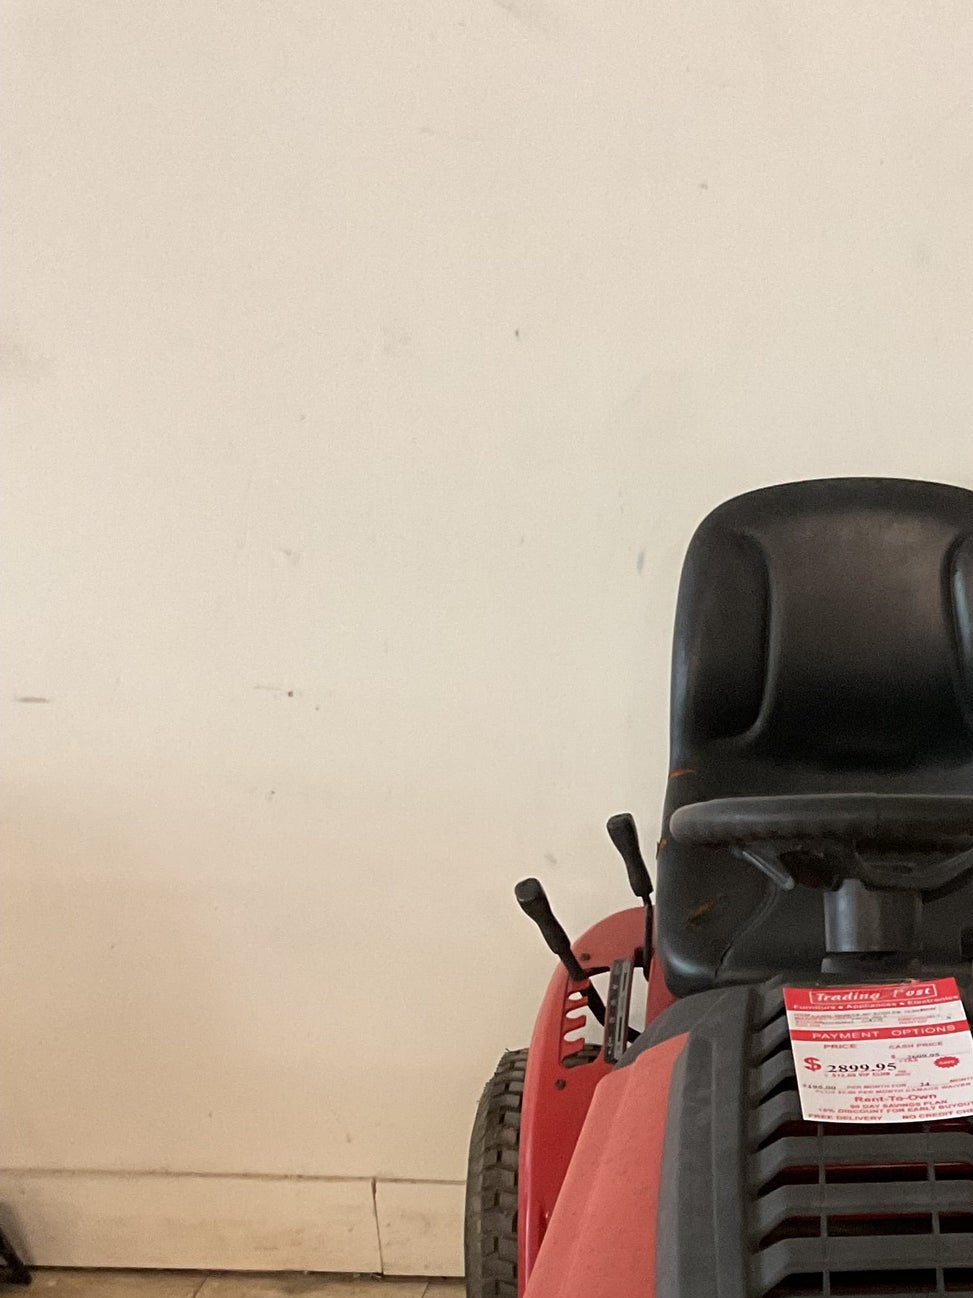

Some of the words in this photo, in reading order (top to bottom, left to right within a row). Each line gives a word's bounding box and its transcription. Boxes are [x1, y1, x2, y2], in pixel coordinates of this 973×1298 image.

[816, 991, 880, 1001] Trading
[812, 1031, 880, 1039] PAYMENT
[891, 1024, 956, 1036] OPTIONS
[827, 1062, 897, 1073] 2899.95
[854, 1094, 937, 1102] Rent-To-Own
